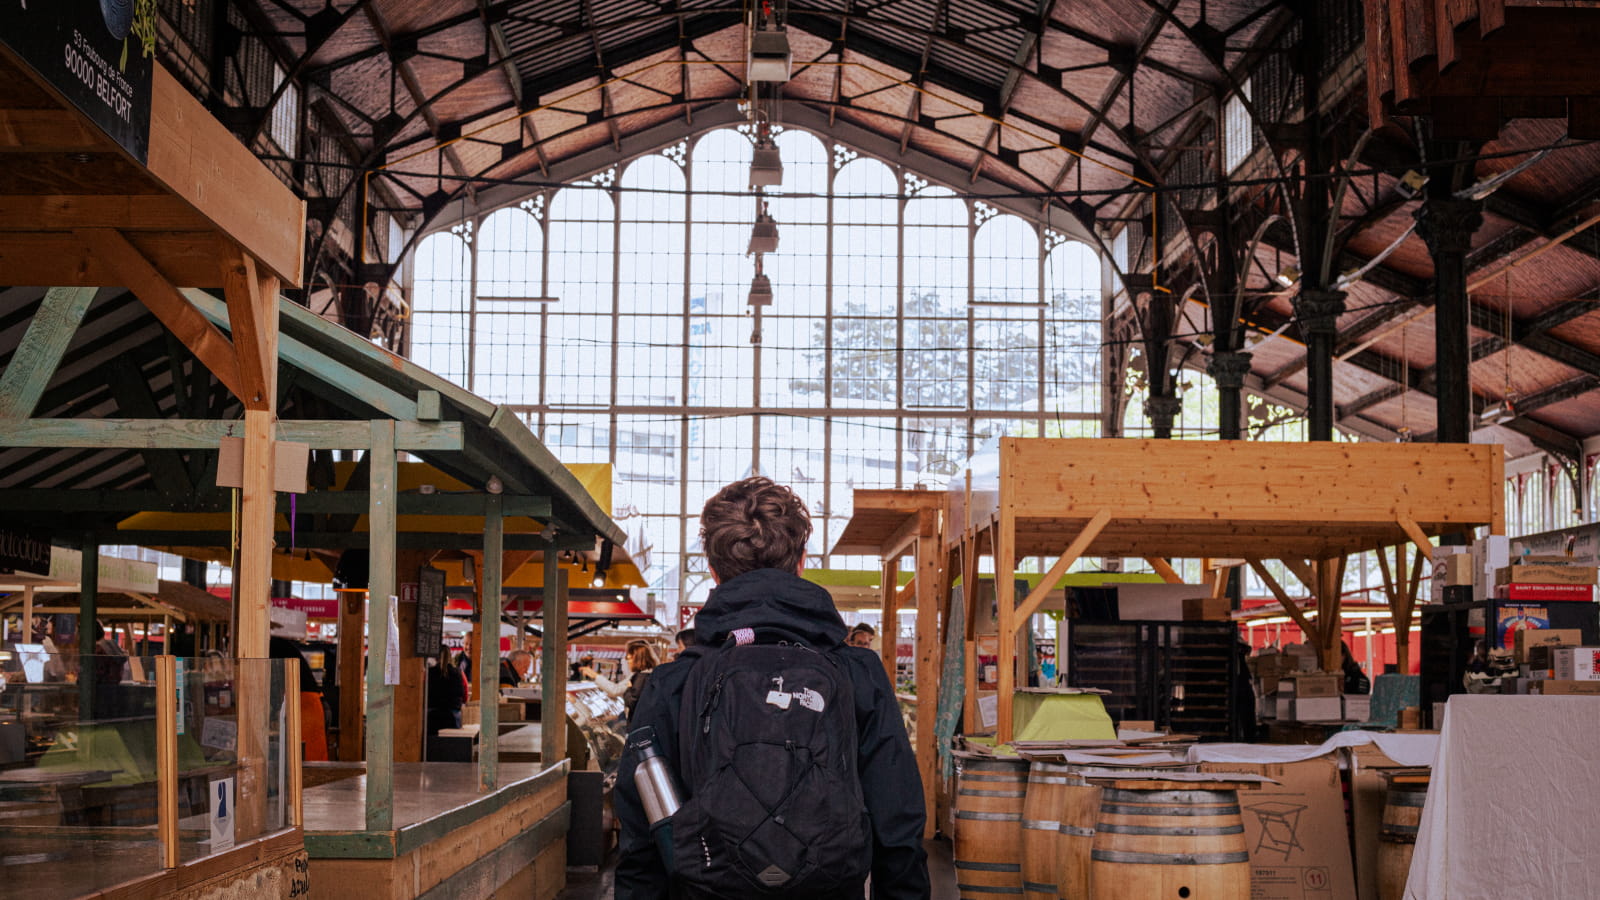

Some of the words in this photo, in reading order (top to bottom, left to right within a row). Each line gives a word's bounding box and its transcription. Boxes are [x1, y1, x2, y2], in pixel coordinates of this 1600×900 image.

[64, 43, 95, 89] 90000
[96, 74, 132, 124] BELFORT
[73, 29, 82, 48] 53
[82, 38, 108, 76] Faubourg
[107, 65, 116, 81] de
[115, 72, 133, 98] France
